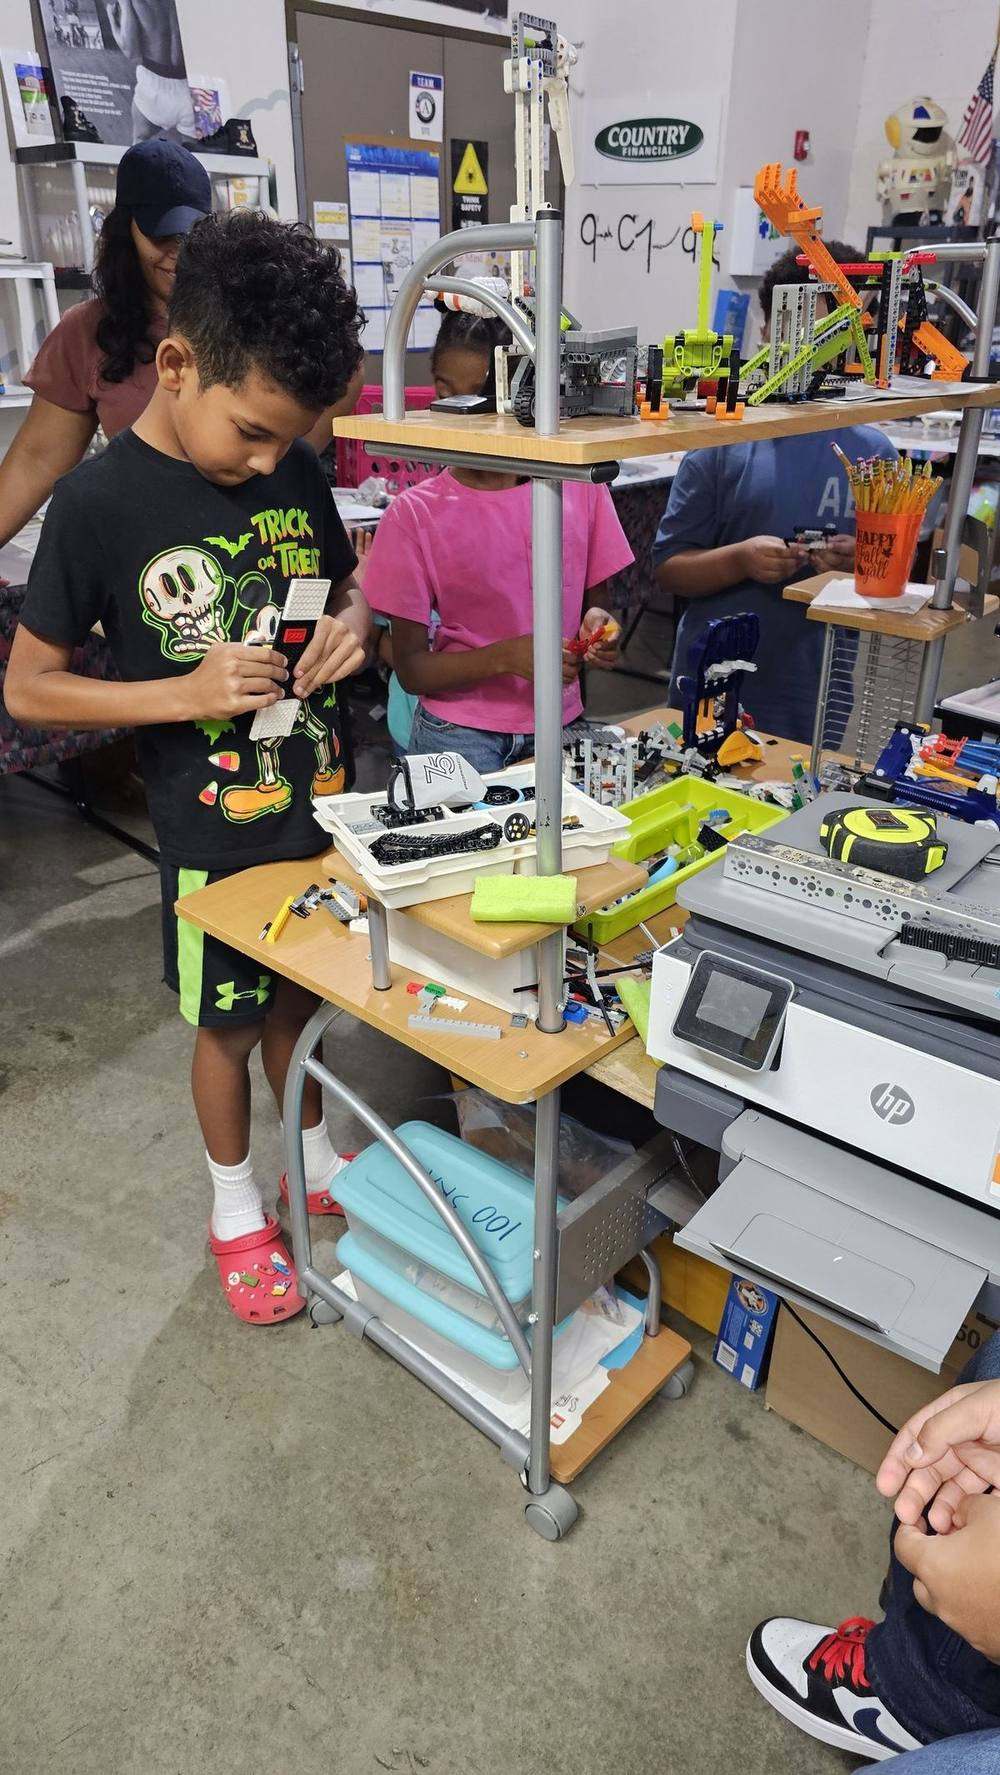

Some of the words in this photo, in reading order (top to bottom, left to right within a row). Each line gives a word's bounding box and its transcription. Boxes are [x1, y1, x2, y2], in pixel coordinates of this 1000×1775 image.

[607, 124, 690, 147] COUNTRY
[250, 508, 314, 545] TRICK
[857, 528, 897, 546] HAPPY
[272, 541, 321, 579] TREAT
[424, 753, 456, 784] 75
[875, 1082, 911, 1122] hp
[472, 1206, 522, 1242] 100
